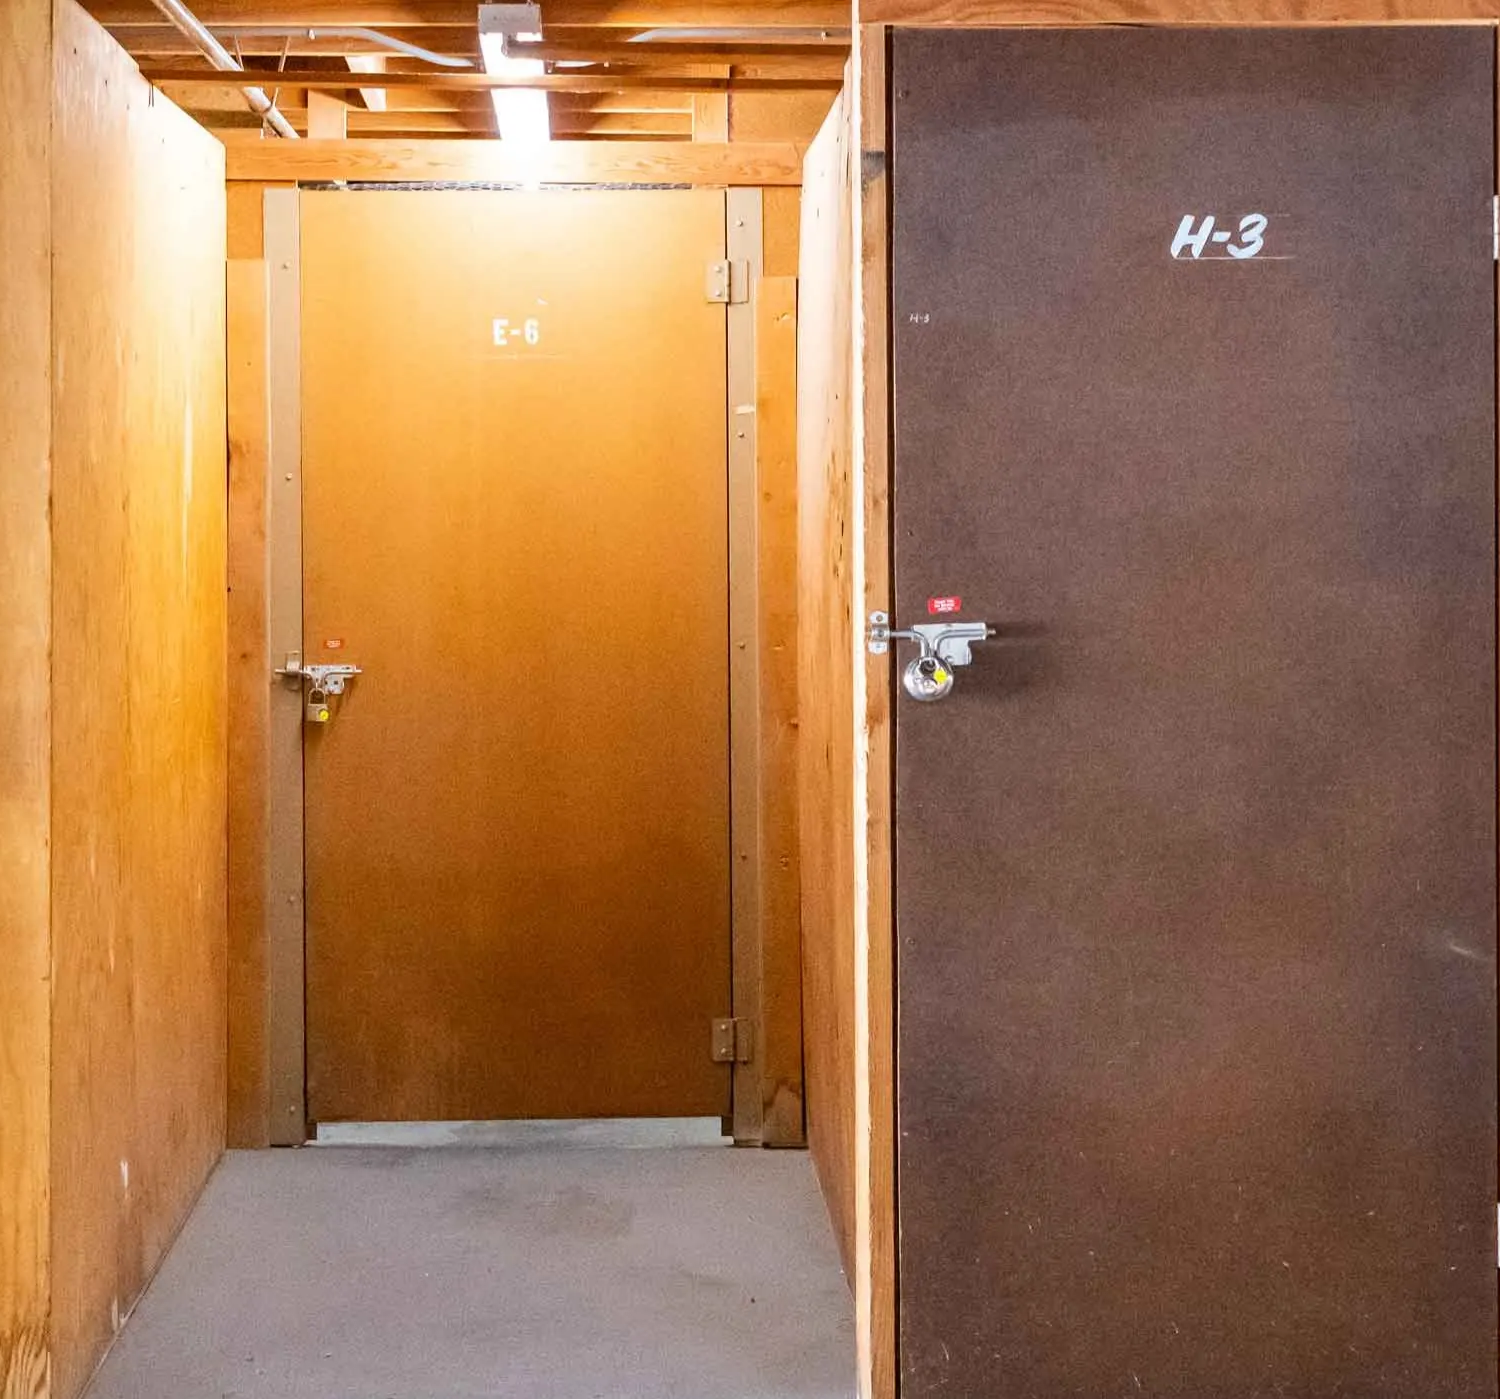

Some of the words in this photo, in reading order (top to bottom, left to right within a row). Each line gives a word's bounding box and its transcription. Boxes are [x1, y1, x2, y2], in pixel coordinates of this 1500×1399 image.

[1170, 213, 1269, 259] H-3
[909, 312, 930, 323] H-3
[492, 318, 540, 346] E-6
